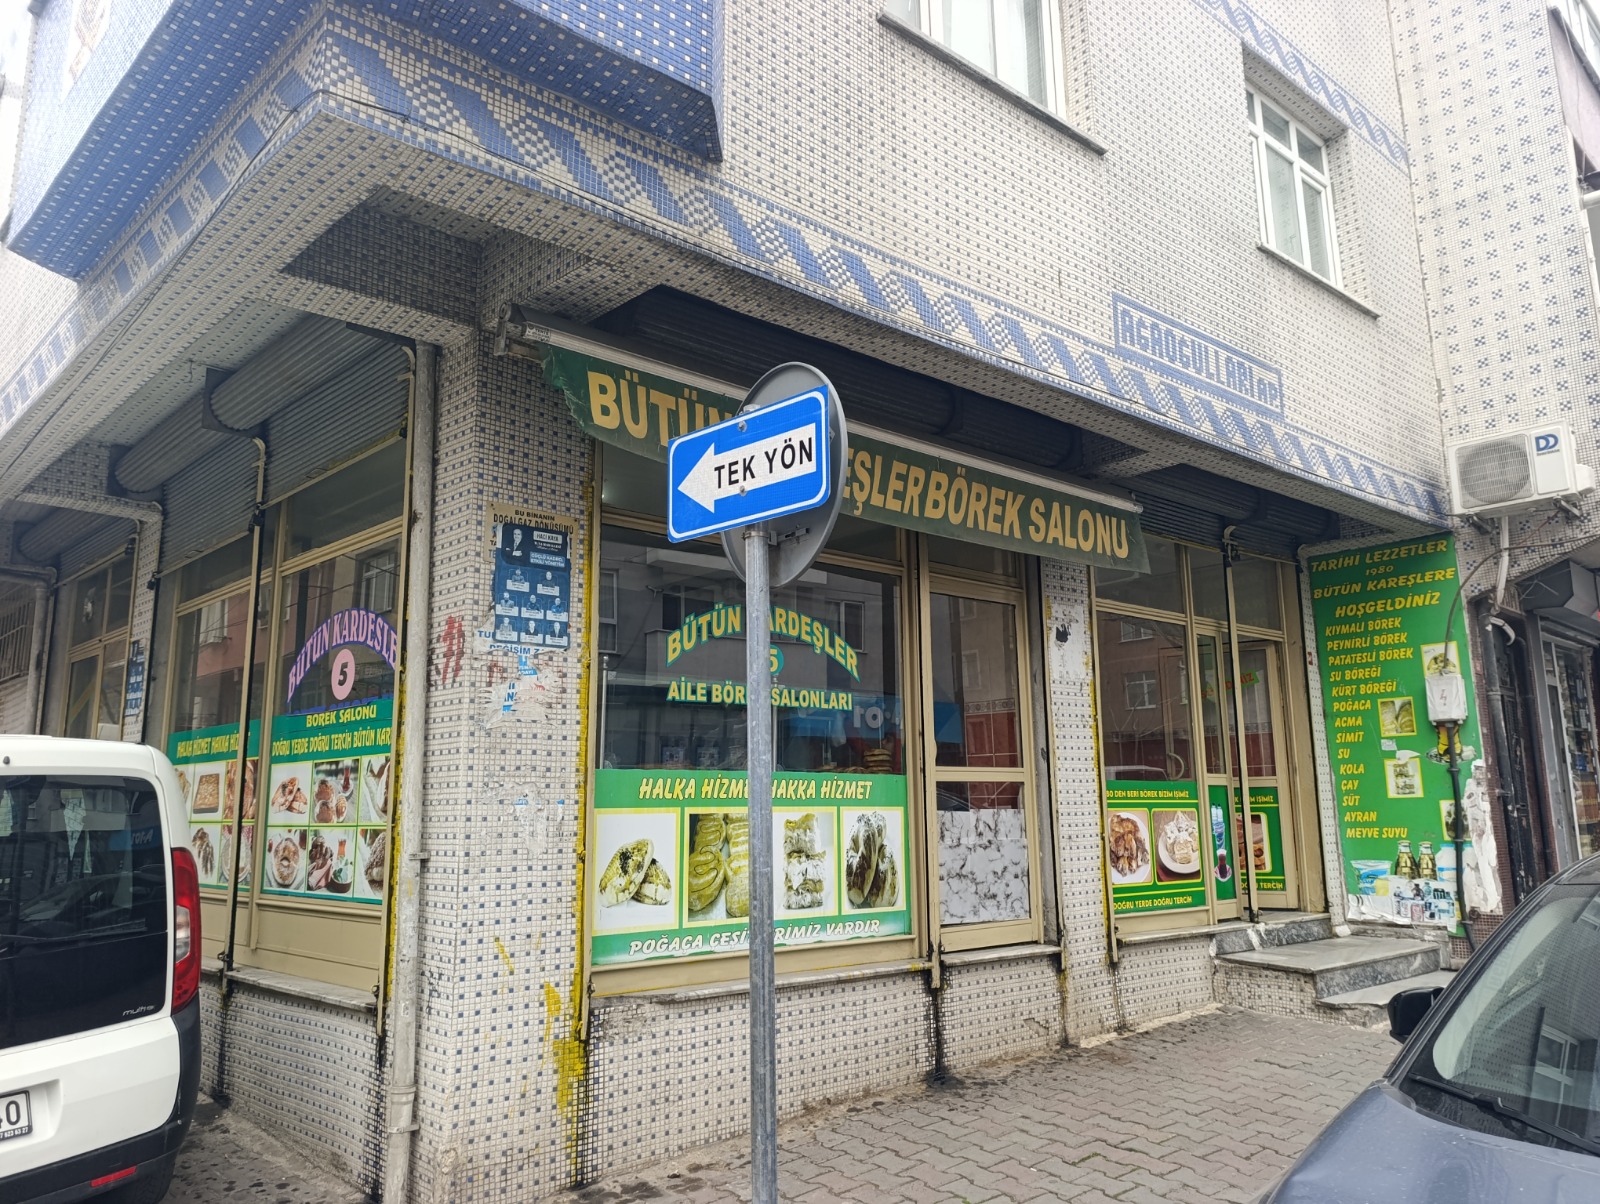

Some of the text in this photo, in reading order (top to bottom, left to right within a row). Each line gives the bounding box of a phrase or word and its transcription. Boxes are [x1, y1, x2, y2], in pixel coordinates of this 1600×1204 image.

[714, 437, 813, 490] TEK YÖN
[924, 466, 1025, 540] BÖREK
[1028, 497, 1129, 559] SALONU
[1311, 540, 1448, 573] TARİHİ LEZZETLER
[1365, 564, 1394, 576] 1980
[1313, 568, 1456, 599] BÜTÜN KAREŞLERE
[1335, 590, 1441, 618] HOŞGELDİNİZ
[666, 601, 742, 667] BÜTÜN
[1325, 616, 1402, 637] KIYMALI BÖREK
[1326, 632, 1408, 651] PEYNİRLİ BÖREK
[1328, 647, 1414, 667] PATATESLİ BÖREK
[337, 661, 349, 687] 5
[1329, 664, 1381, 682] SU BÖREĞİ
[666, 677, 707, 702] AİLE
[771, 687, 853, 711] SALONLARI
[1332, 679, 1397, 697] KÜRT BÖREĞİ
[339, 704, 377, 724] SALONU
[353, 726, 375, 748] BÜTÜN
[1336, 731, 1364, 744] SİMİT
[1338, 748, 1350, 759] SU
[1339, 764, 1365, 775] KOLA
[638, 777, 696, 800] HALKA
[820, 775, 873, 800] HİZMET
[1139, 788, 1158, 798] BÖREK
[1341, 779, 1359, 794] ÇAY
[1342, 793, 1360, 807] SÜT
[1344, 811, 1377, 822] AYRAN
[1346, 827, 1408, 839] MEYVE SUYU
[1113, 899, 1134, 910] DOĞRU
[1134, 898, 1153, 909] YERDE
[1153, 896, 1173, 907] DOĞRU
[628, 934, 704, 956] POĞAÇA
[825, 919, 880, 936] VARDIR
